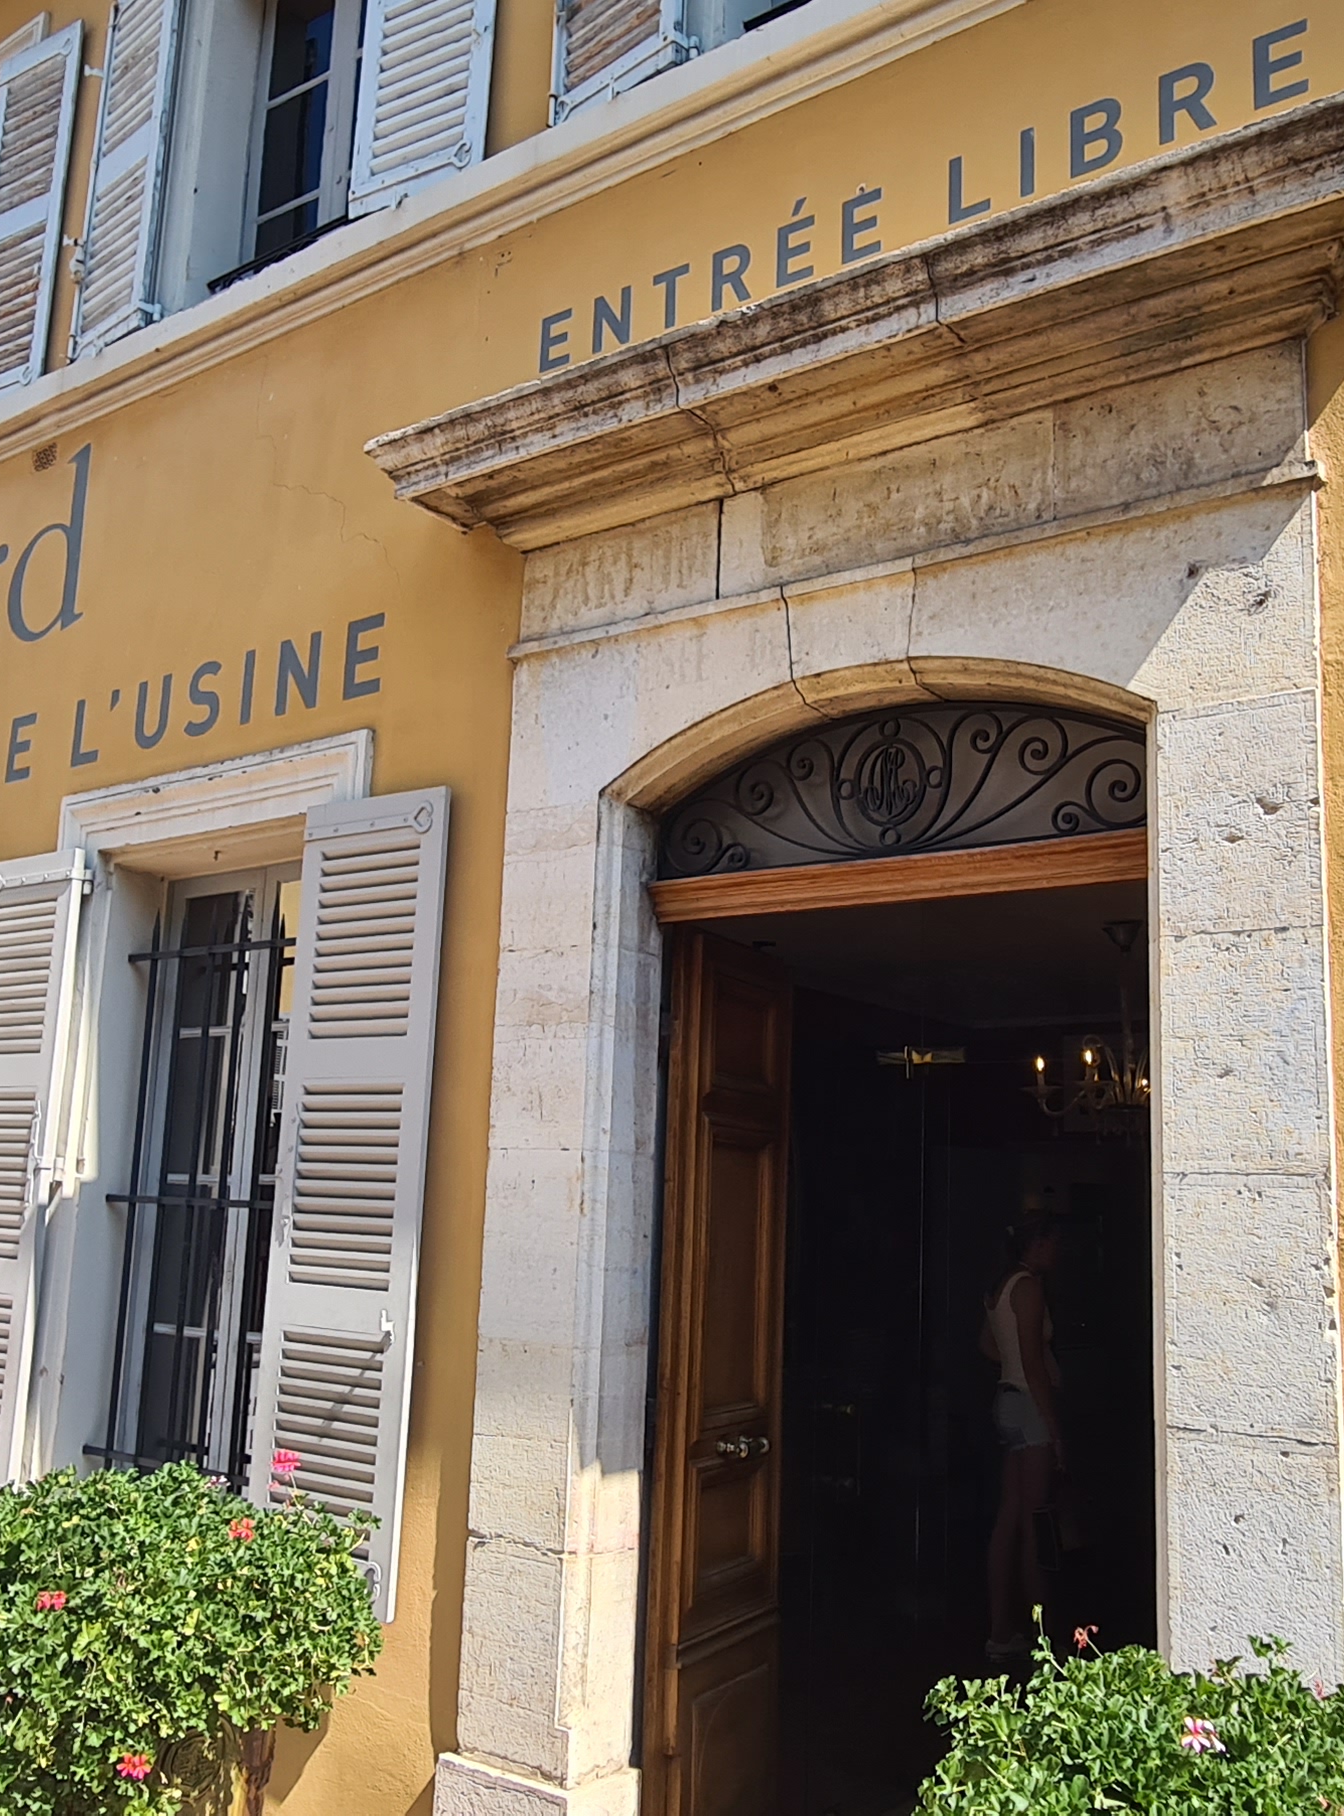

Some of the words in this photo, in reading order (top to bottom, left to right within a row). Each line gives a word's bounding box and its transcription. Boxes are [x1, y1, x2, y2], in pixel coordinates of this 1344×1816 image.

[538, 187, 884, 373] ENTRÉE
[947, 18, 1309, 225] LIBRE
[70, 612, 386, 768] L'USINE
